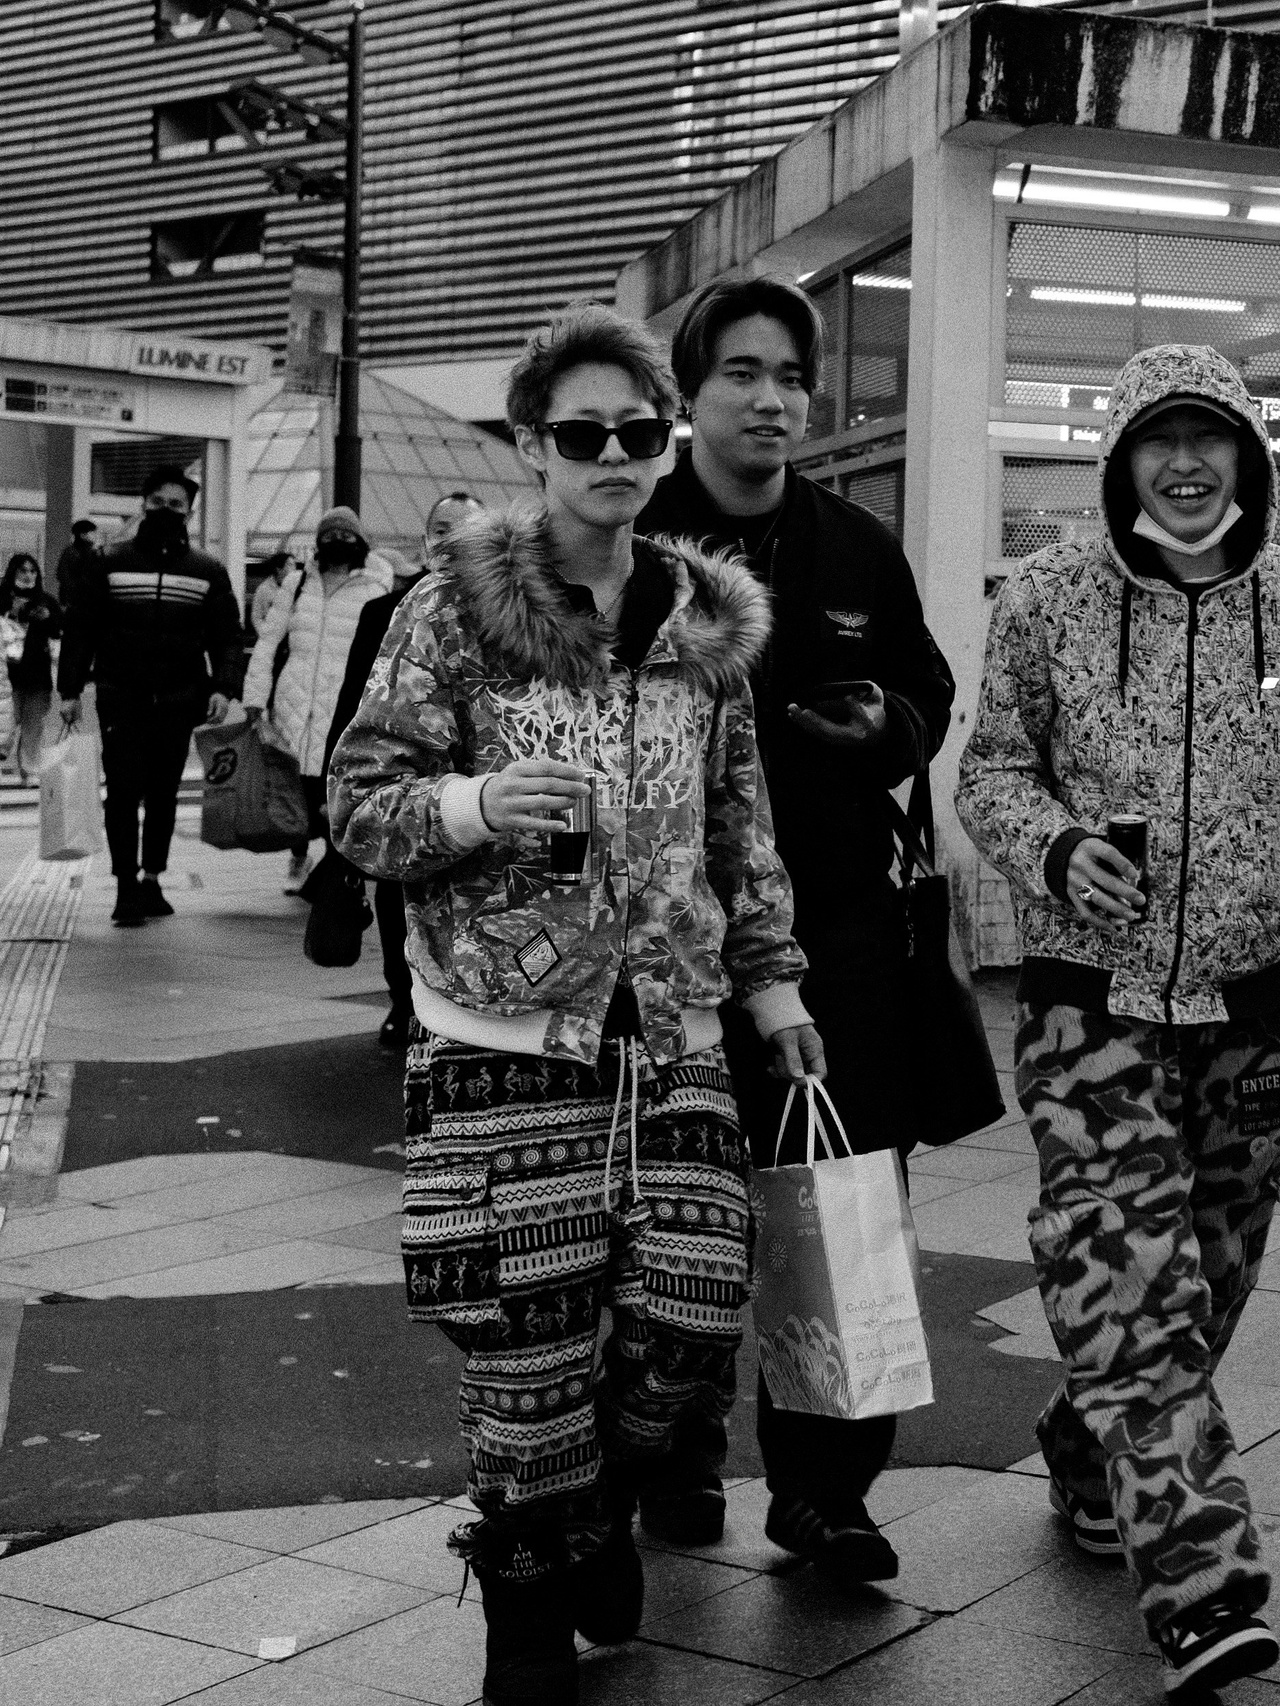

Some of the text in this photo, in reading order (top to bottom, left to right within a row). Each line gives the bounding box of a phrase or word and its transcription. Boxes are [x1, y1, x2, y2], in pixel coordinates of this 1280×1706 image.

[137, 346, 251, 376] LUMINE EST
[1241, 1074, 1280, 1094] ENYCE
[518, 1543, 522, 1551] I
[512, 1550, 533, 1561] AM
[511, 1558, 537, 1569] THE
